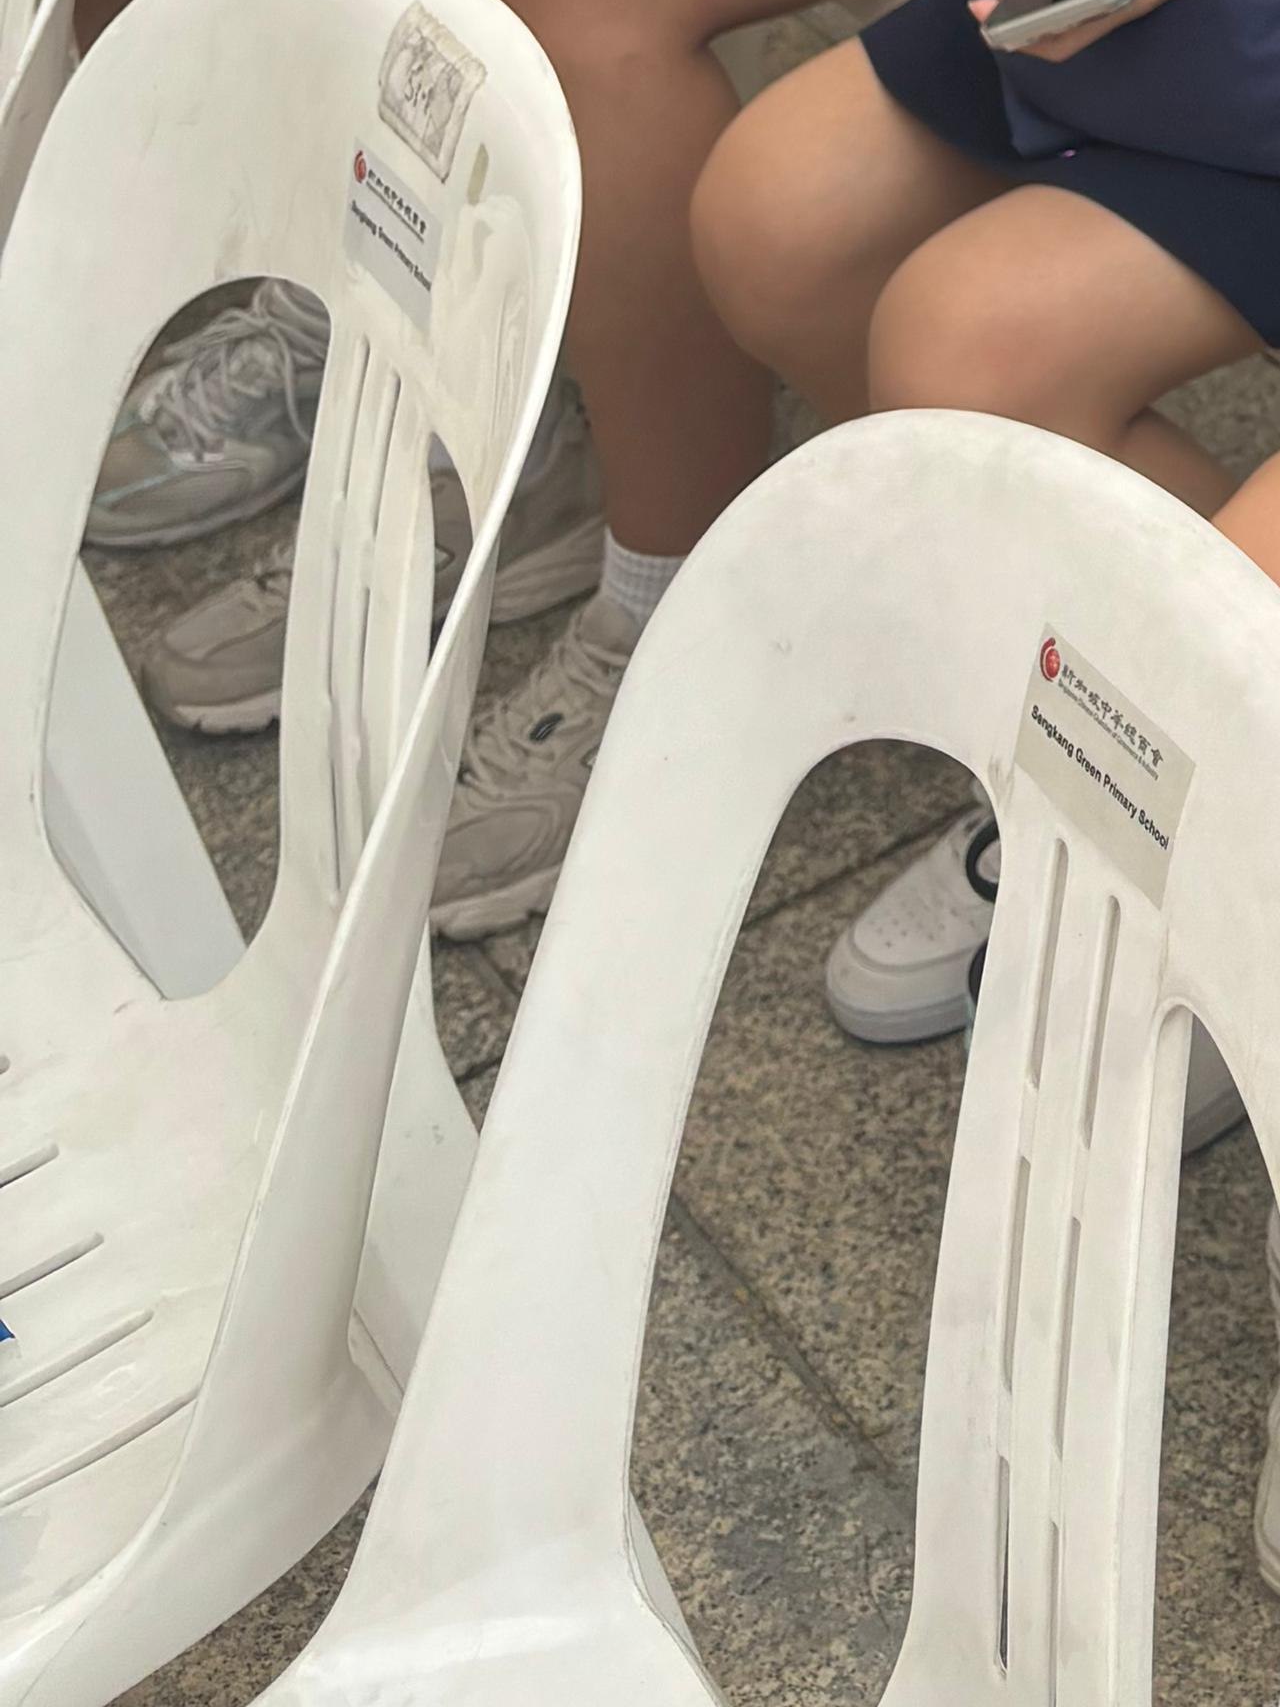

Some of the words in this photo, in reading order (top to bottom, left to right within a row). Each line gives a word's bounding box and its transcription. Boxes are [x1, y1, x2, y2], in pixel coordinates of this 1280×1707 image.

[1031, 705, 1074, 758] Sengkang
[1075, 748, 1102, 783] Green
[1103, 774, 1138, 819] Primary
[1138, 809, 1170, 850] School
